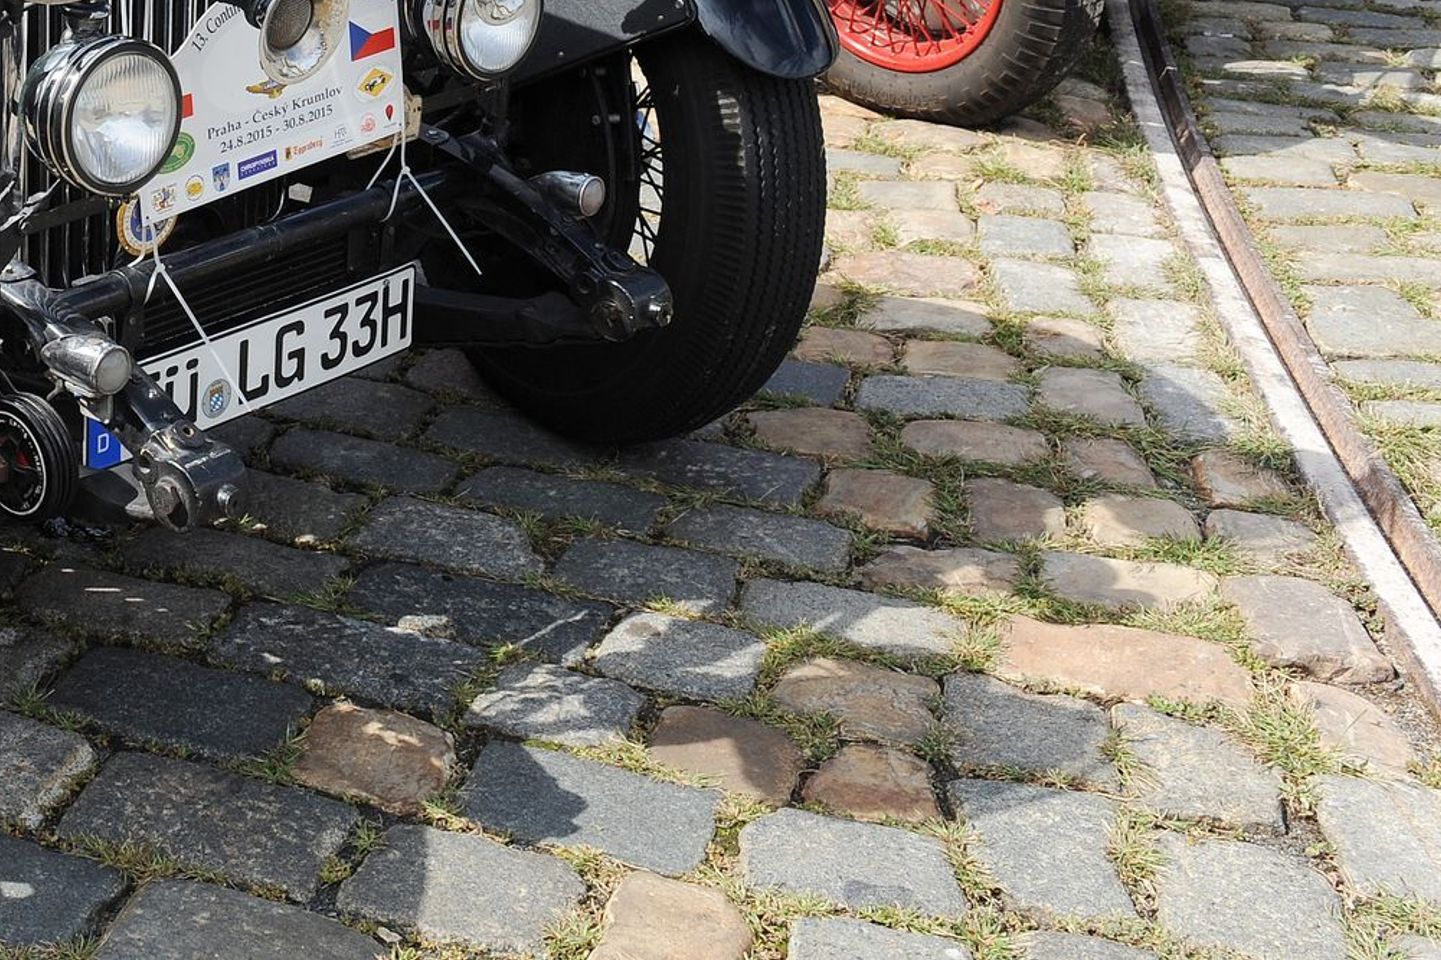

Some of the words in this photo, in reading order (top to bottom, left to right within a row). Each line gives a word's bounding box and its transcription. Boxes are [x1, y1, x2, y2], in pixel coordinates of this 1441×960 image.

[191, 32, 209, 52] 13.
[207, 122, 243, 141] Praha
[252, 99, 289, 125] Český
[292, 85, 344, 111] Krumlov
[219, 127, 273, 154] 24.8.2015
[283, 104, 334, 131] 30.8.2015
[149, 358, 199, 424] Ü
[238, 320, 305, 404] LG
[320, 277, 410, 371] 33H
[96, 431, 110, 454] D
